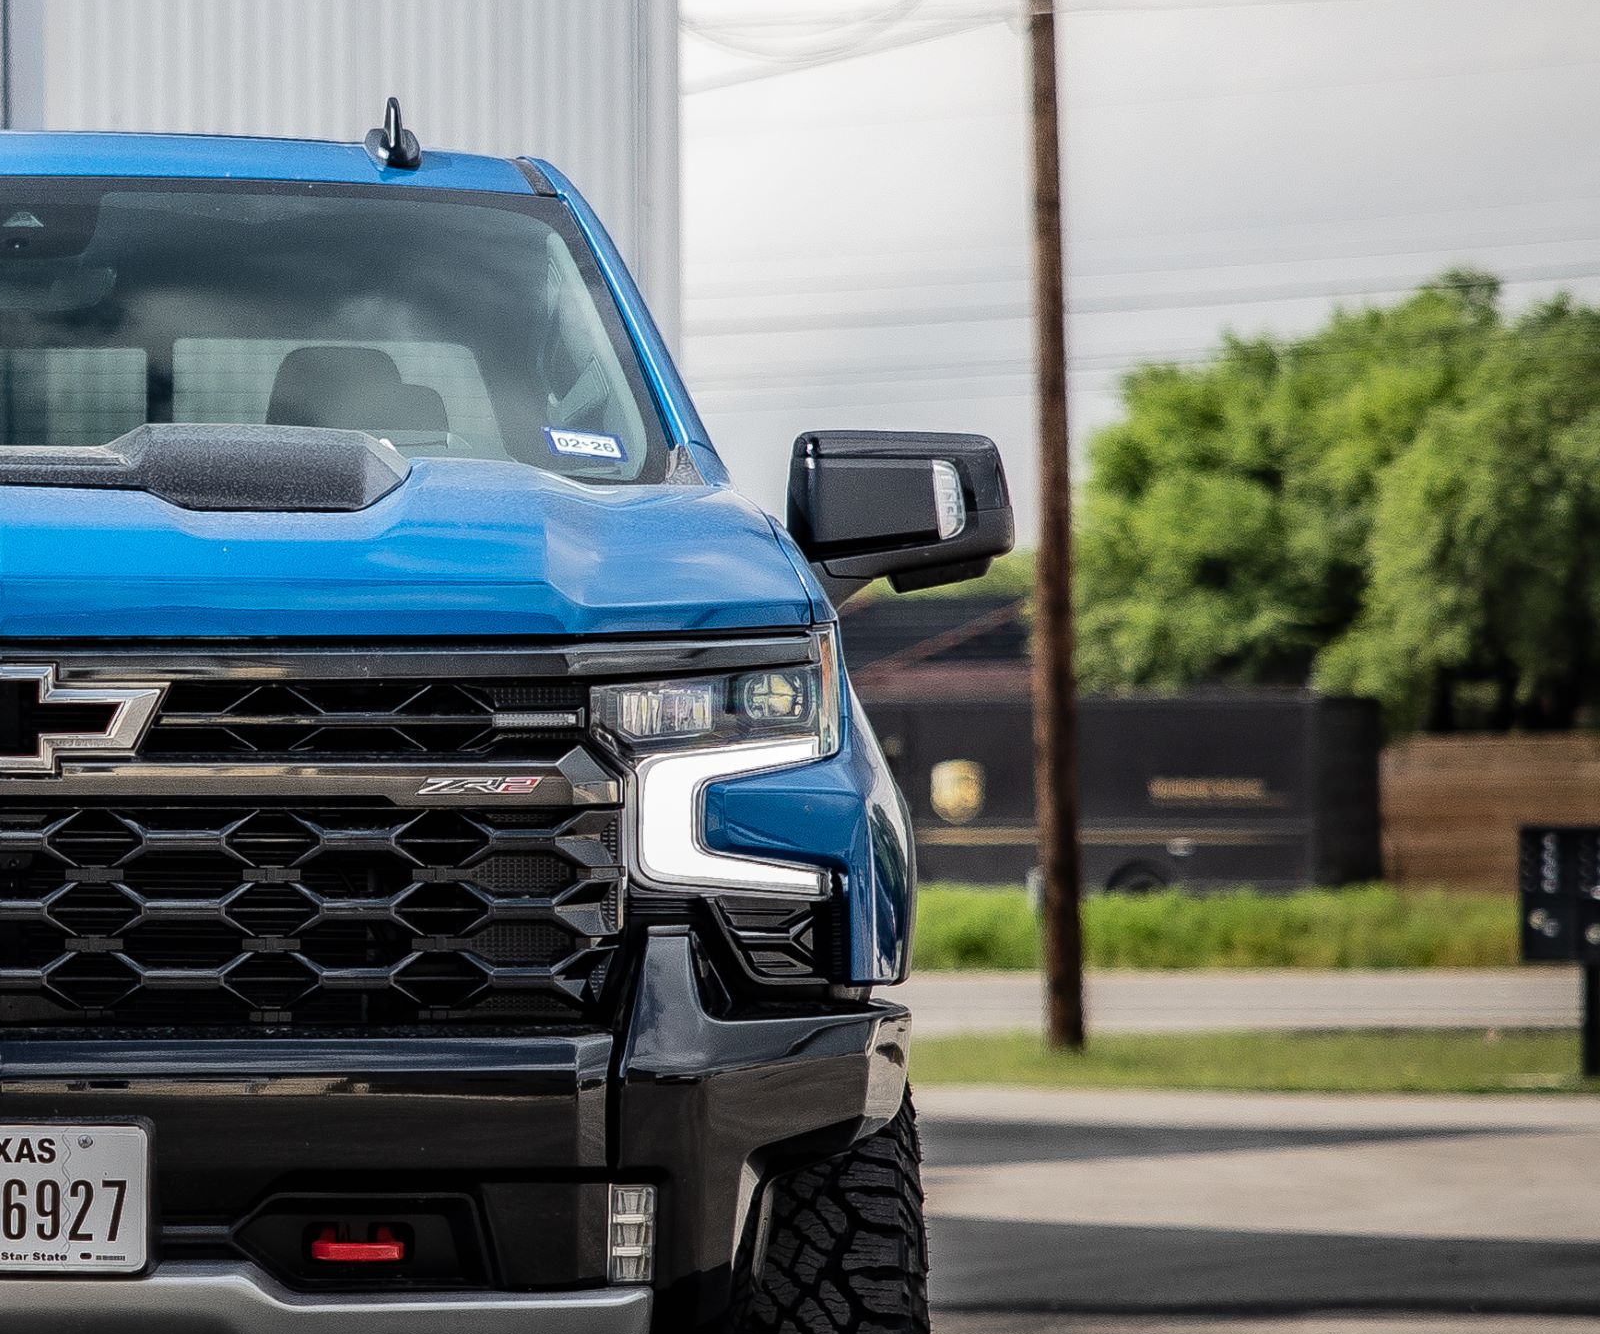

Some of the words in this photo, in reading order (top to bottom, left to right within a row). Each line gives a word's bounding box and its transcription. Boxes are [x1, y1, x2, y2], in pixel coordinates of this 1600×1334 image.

[416, 776, 544, 795] ZR2
[2, 1178, 128, 1242] 6927
[1, 1252, 29, 1262] Star
[32, 1252, 68, 1262] State
